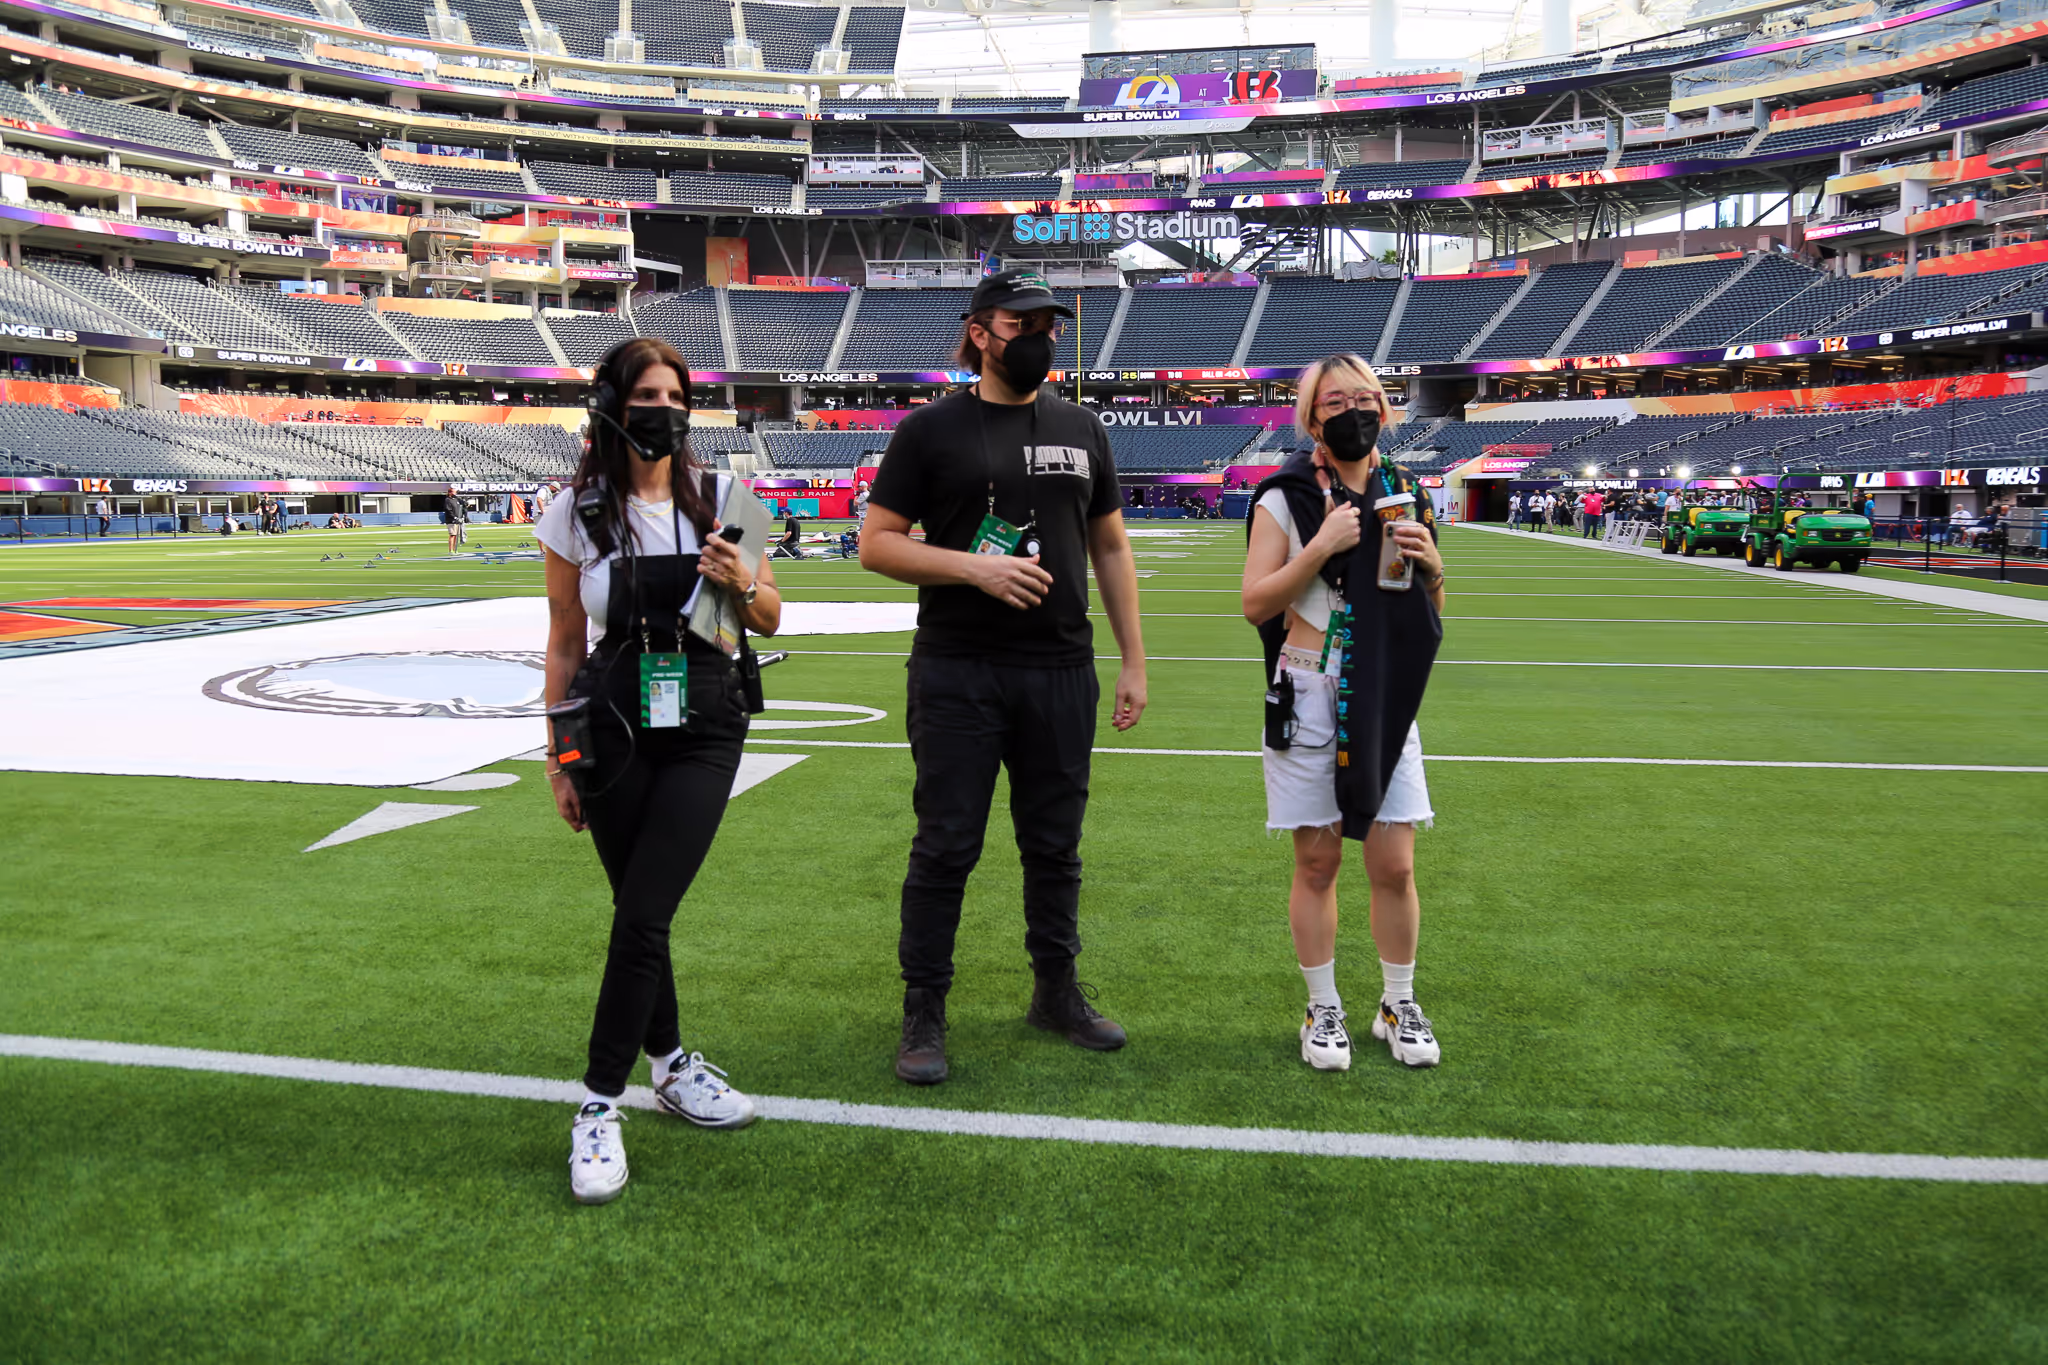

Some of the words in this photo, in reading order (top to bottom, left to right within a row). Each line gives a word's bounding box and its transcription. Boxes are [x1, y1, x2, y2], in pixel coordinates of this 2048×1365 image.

[1198, 88, 1207, 97] AT
[1426, 93, 1456, 104] LOS
[1457, 85, 1527, 102] ANGELES
[1083, 112, 1123, 122] SUPER
[1125, 111, 1162, 121] BOWL
[1163, 110, 1180, 119] LVI
[470, 123, 500, 131] SHORT
[644, 139, 687, 147] LOCATION
[1861, 135, 1884, 146] LOS
[1884, 122, 1941, 142] ANGELES
[1367, 188, 1413, 200] BENGALS
[1190, 198, 1216, 208] RAMS
[753, 206, 773, 214] LOS
[774, 207, 823, 215] ANGELES
[1014, 213, 1078, 242] SoFi
[1115, 210, 1239, 241] Stadium
[177, 232, 230, 249] SUPER
[233, 239, 280, 255] BOWL
[281, 245, 304, 258] LVI
[572, 269, 591, 277] LOS
[592, 270, 635, 280] ANGELES
[1911, 326, 1951, 340] SUPER
[1951, 322, 1988, 336] BOWL
[1988, 319, 2008, 331] LVI
[217, 350, 257, 362] SUPER
[259, 352, 295, 364] BOWL
[295, 354, 311, 366] LVI
[1122, 372, 1137, 380] 25
[1224, 370, 1241, 378] 40
[1371, 366, 1422, 376] GELES
[780, 373, 808, 383] LOS
[809, 373, 878, 382] ANGELES
[1096, 411, 1159, 426] OWL
[1164, 410, 1202, 426] LVI
[1484, 461, 1502, 469] LOS
[1986, 466, 2041, 485] BENGALS
[133, 478, 188, 492] BENGALS
[450, 482, 487, 492] SUPER
[489, 482, 523, 492] BOWL
[523, 482, 539, 492] LVI
